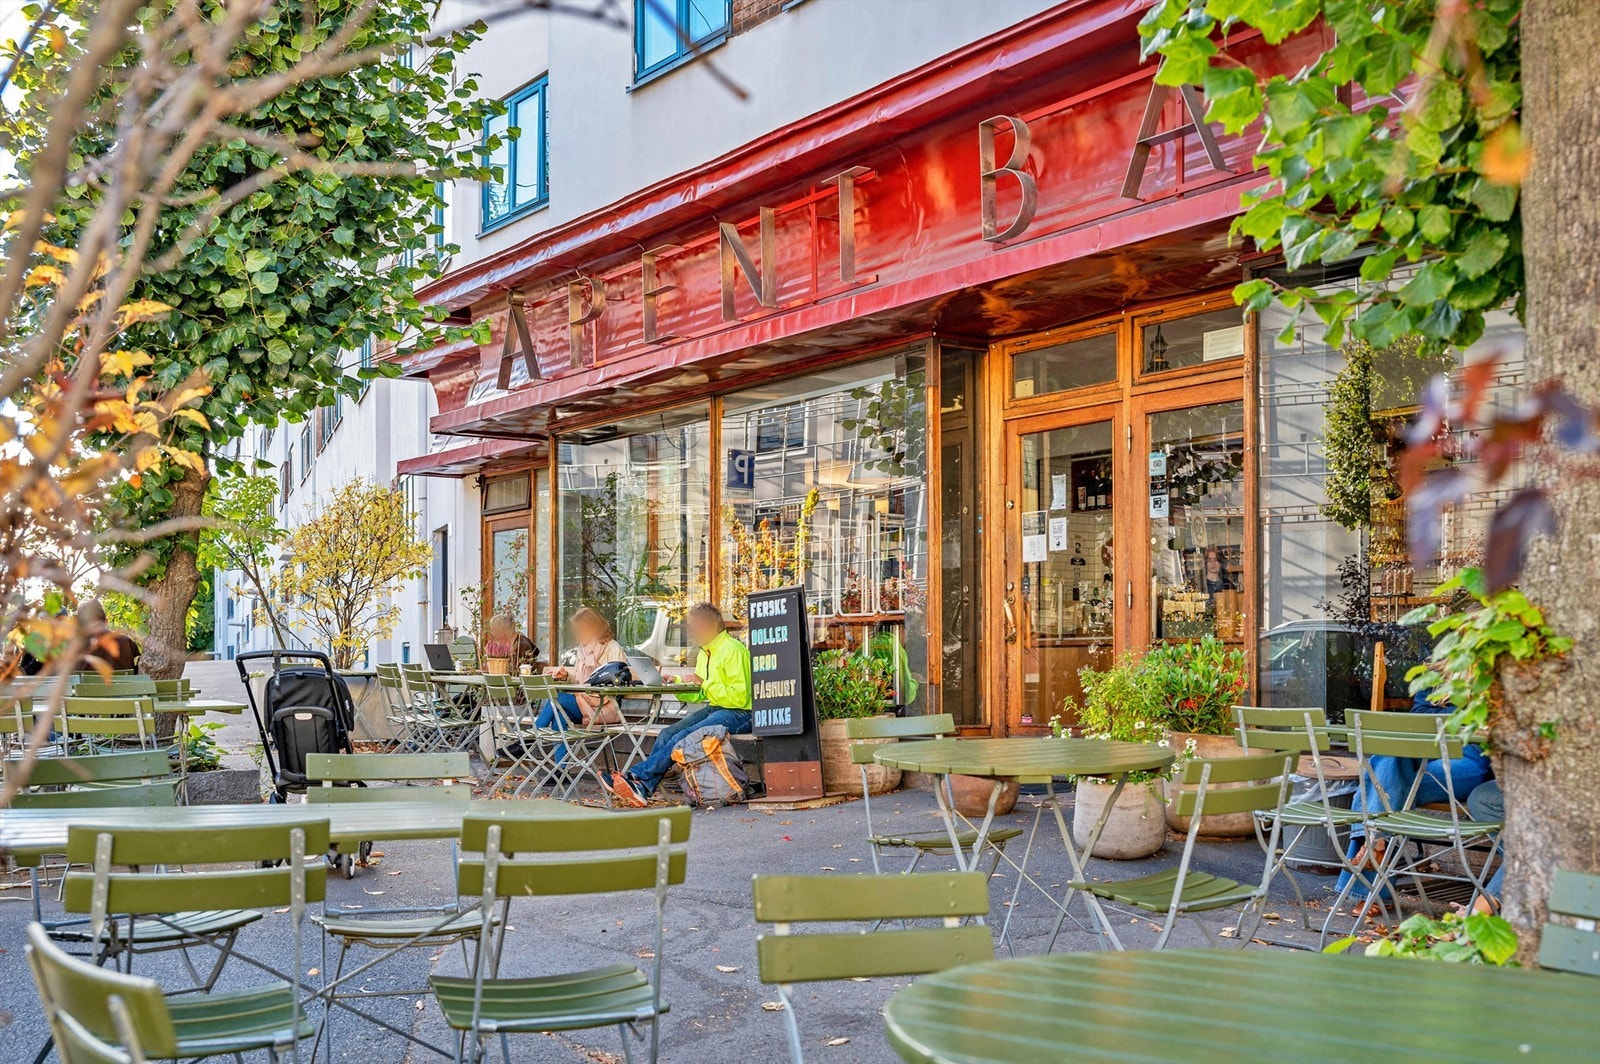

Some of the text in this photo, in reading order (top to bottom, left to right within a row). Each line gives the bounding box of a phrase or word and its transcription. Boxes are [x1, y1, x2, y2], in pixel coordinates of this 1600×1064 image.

[750, 598, 788, 619] FERSKE
[753, 679, 797, 700] PÅSMURT
[754, 707, 792, 728] DRIKKE
